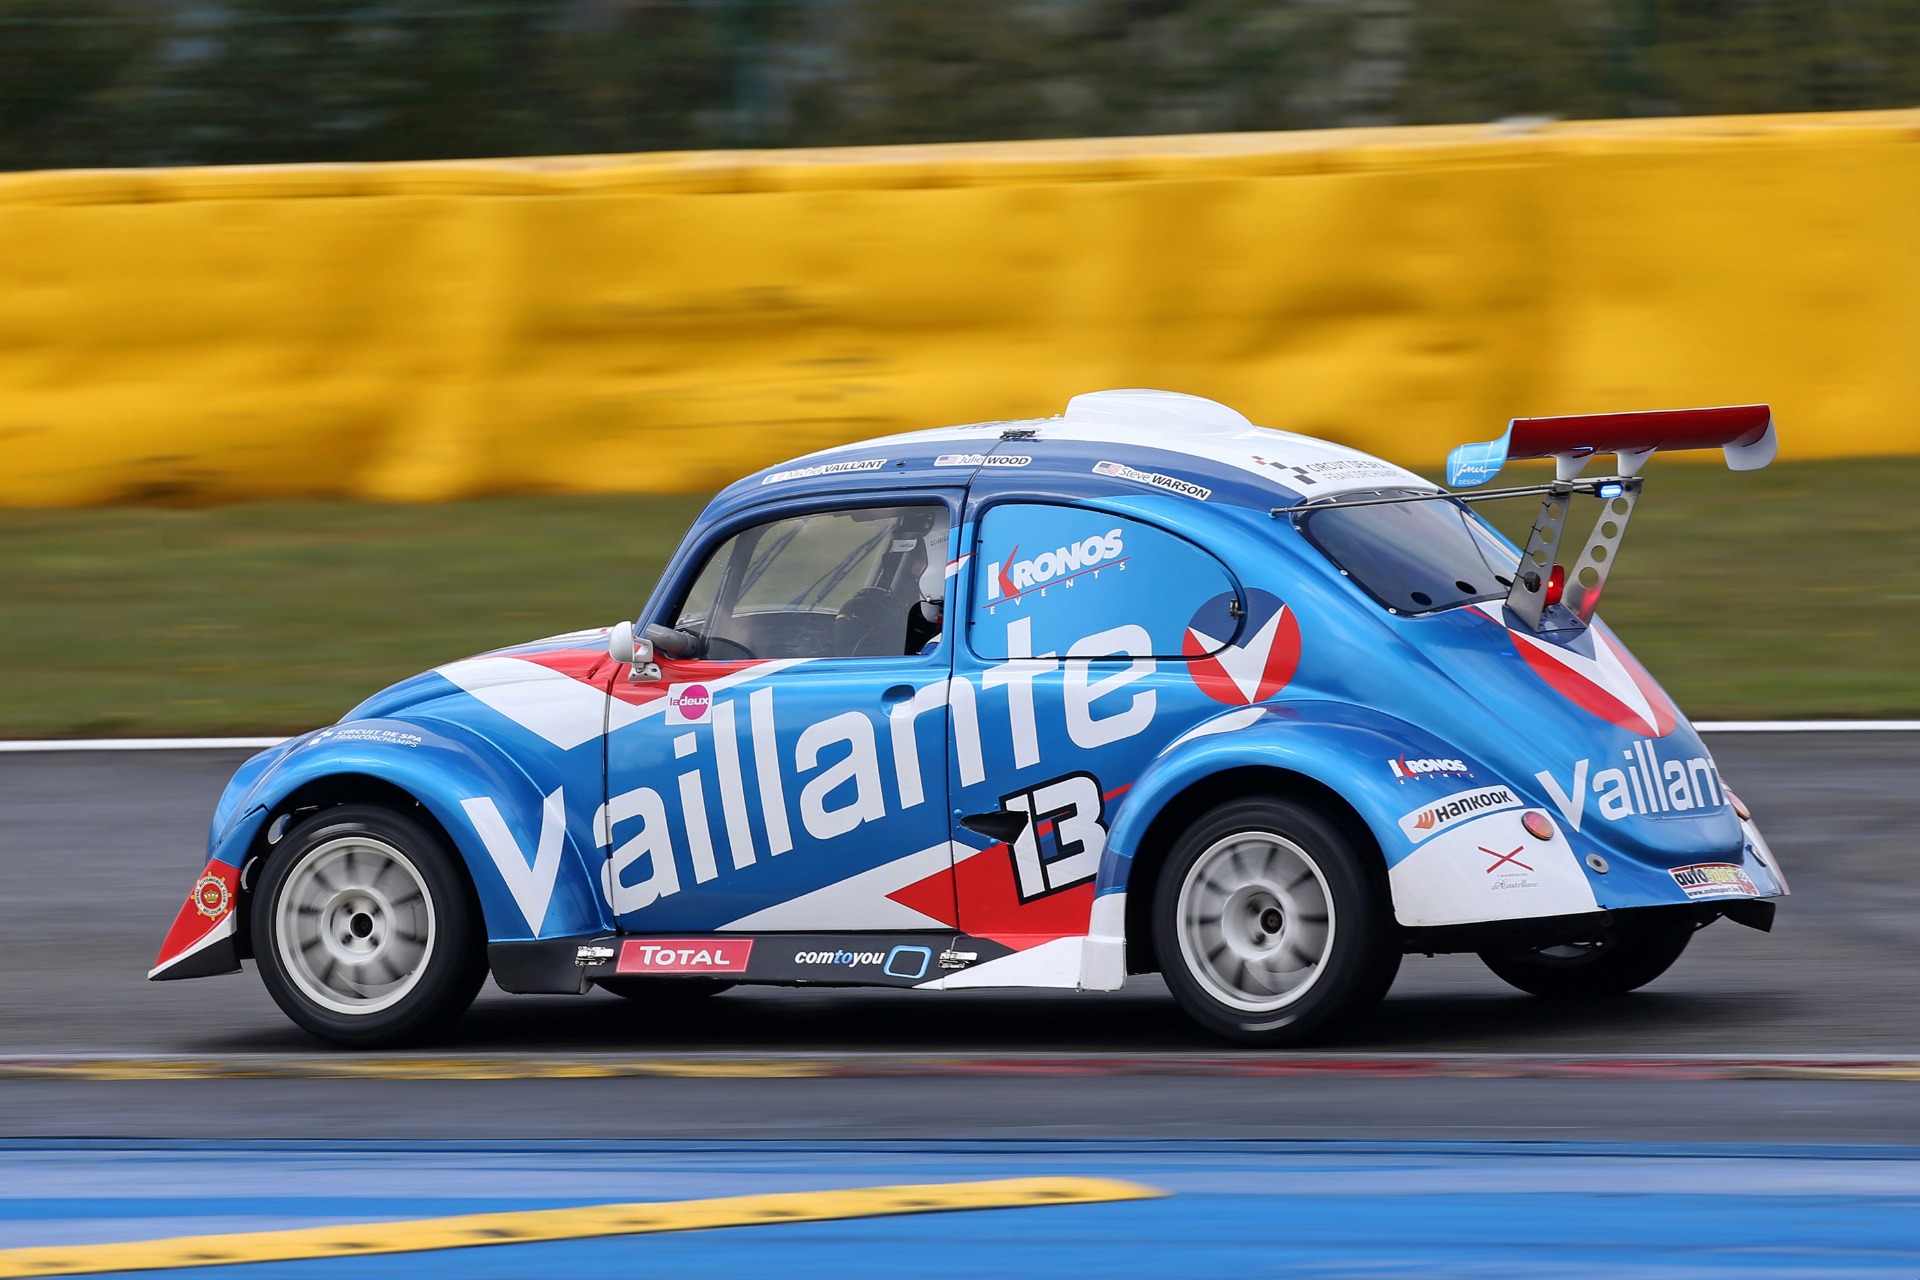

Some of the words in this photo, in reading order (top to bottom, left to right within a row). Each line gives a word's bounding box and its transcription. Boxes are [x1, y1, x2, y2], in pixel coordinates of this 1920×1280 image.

[824, 460, 885, 472] VAILLANT
[958, 455, 983, 464] Julie
[987, 457, 1029, 465] WOOD
[1119, 467, 1150, 481] Steve
[1151, 475, 1209, 498] WARSON
[987, 528, 1123, 600] KRONOS
[989, 561, 1126, 615] EVENTS
[332, 734, 418, 748] FRANCORCHAMPS
[399, 732, 422, 743] SPA
[1388, 754, 1468, 777] KRONOS
[1000, 771, 1110, 905] 13
[639, 945, 731, 966] TOTAL
[794, 950, 885, 967] comtoyou
